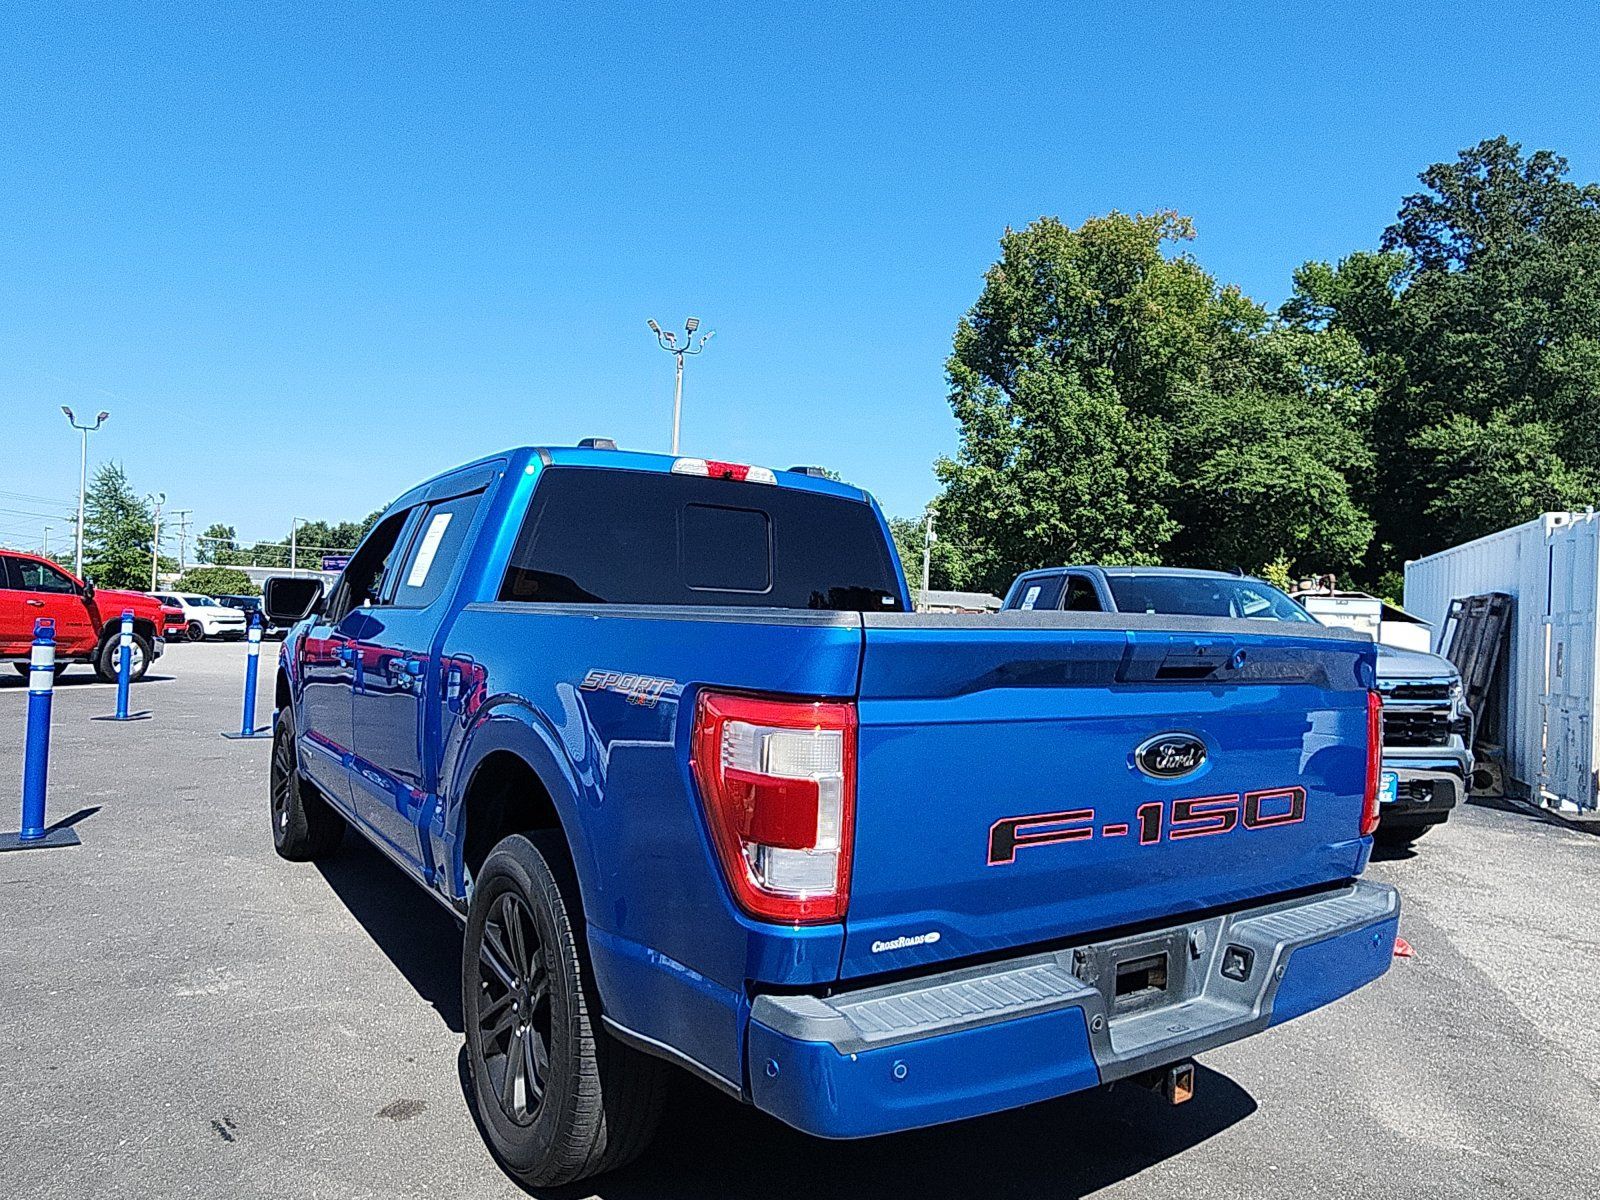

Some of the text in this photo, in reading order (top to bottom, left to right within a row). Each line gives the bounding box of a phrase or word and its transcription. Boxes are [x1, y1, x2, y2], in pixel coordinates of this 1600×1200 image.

[579, 668, 676, 696] SPORT
[1156, 743, 1195, 769] Ford
[987, 785, 1307, 866] F-150
